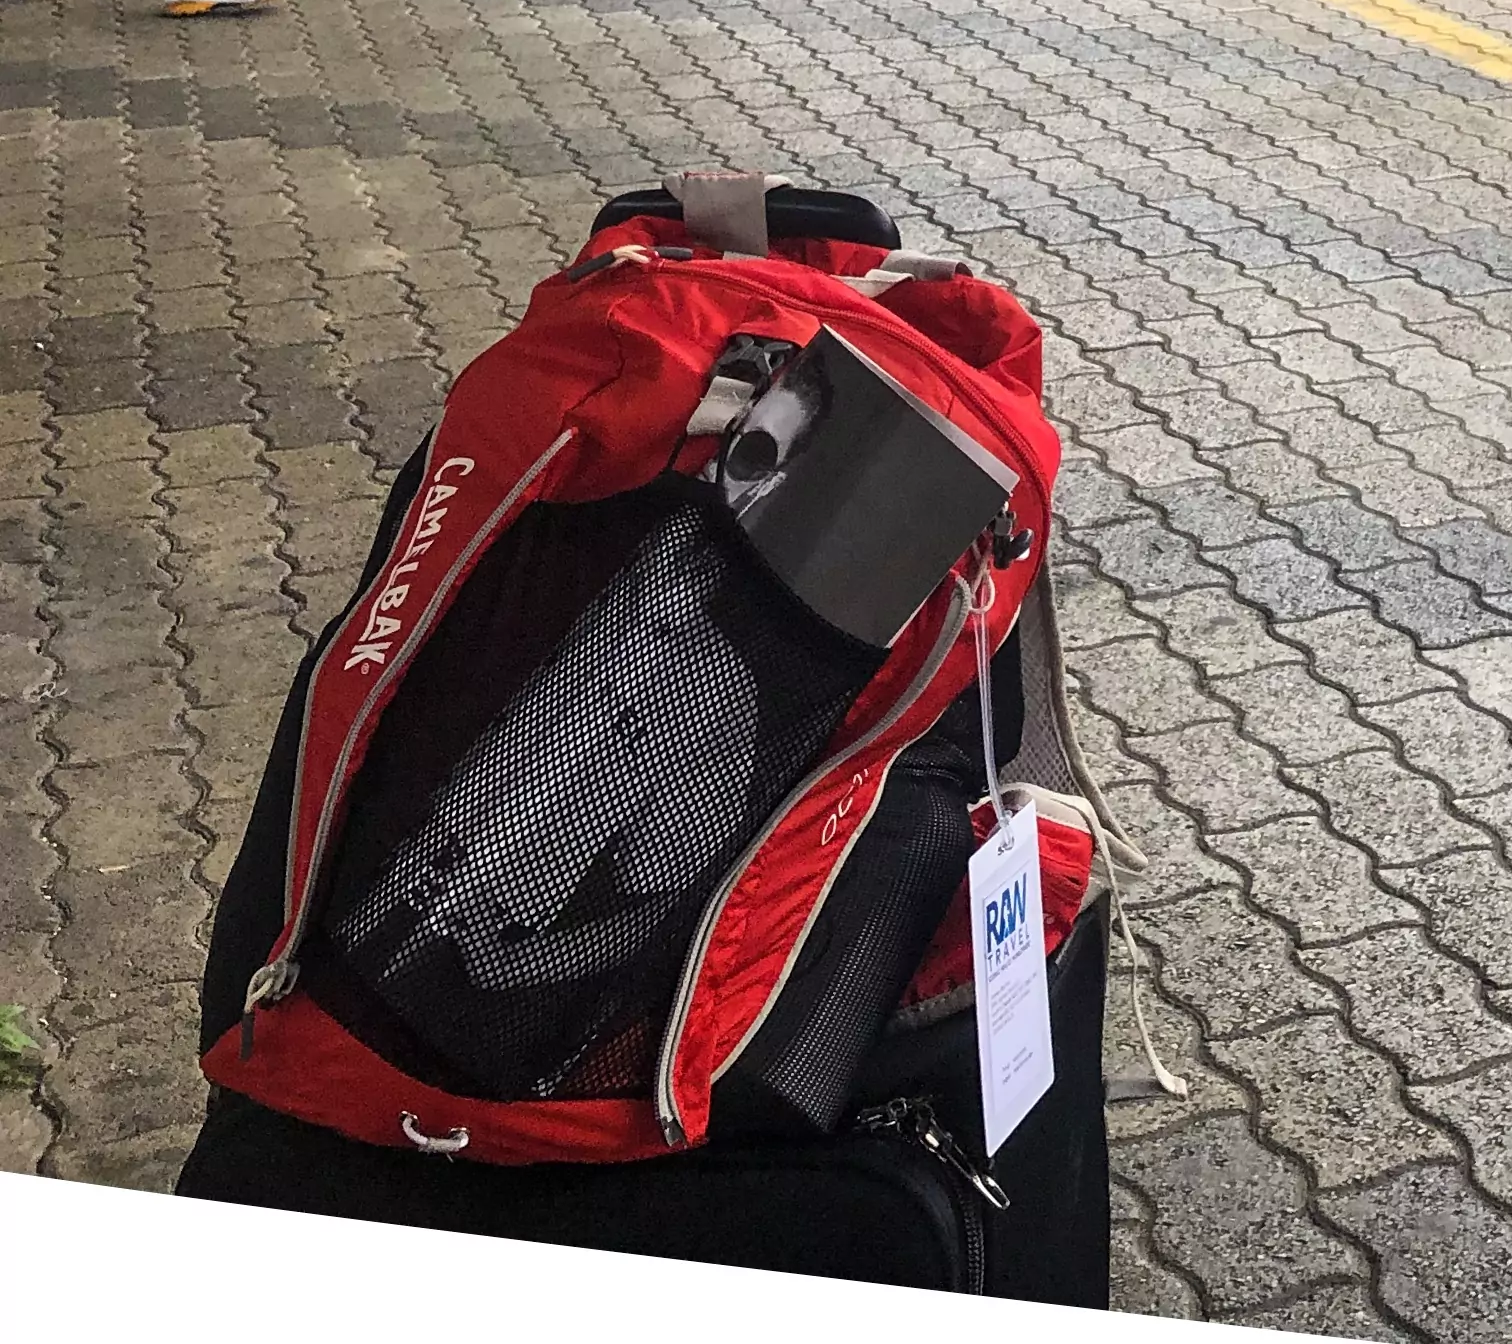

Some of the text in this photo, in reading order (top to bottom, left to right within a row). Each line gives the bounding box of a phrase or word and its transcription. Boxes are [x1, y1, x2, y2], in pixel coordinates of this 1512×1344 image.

[344, 456, 475, 672] CAMELBAK
[986, 872, 1027, 954] RAW
[987, 922, 1030, 973] TRAVEL
